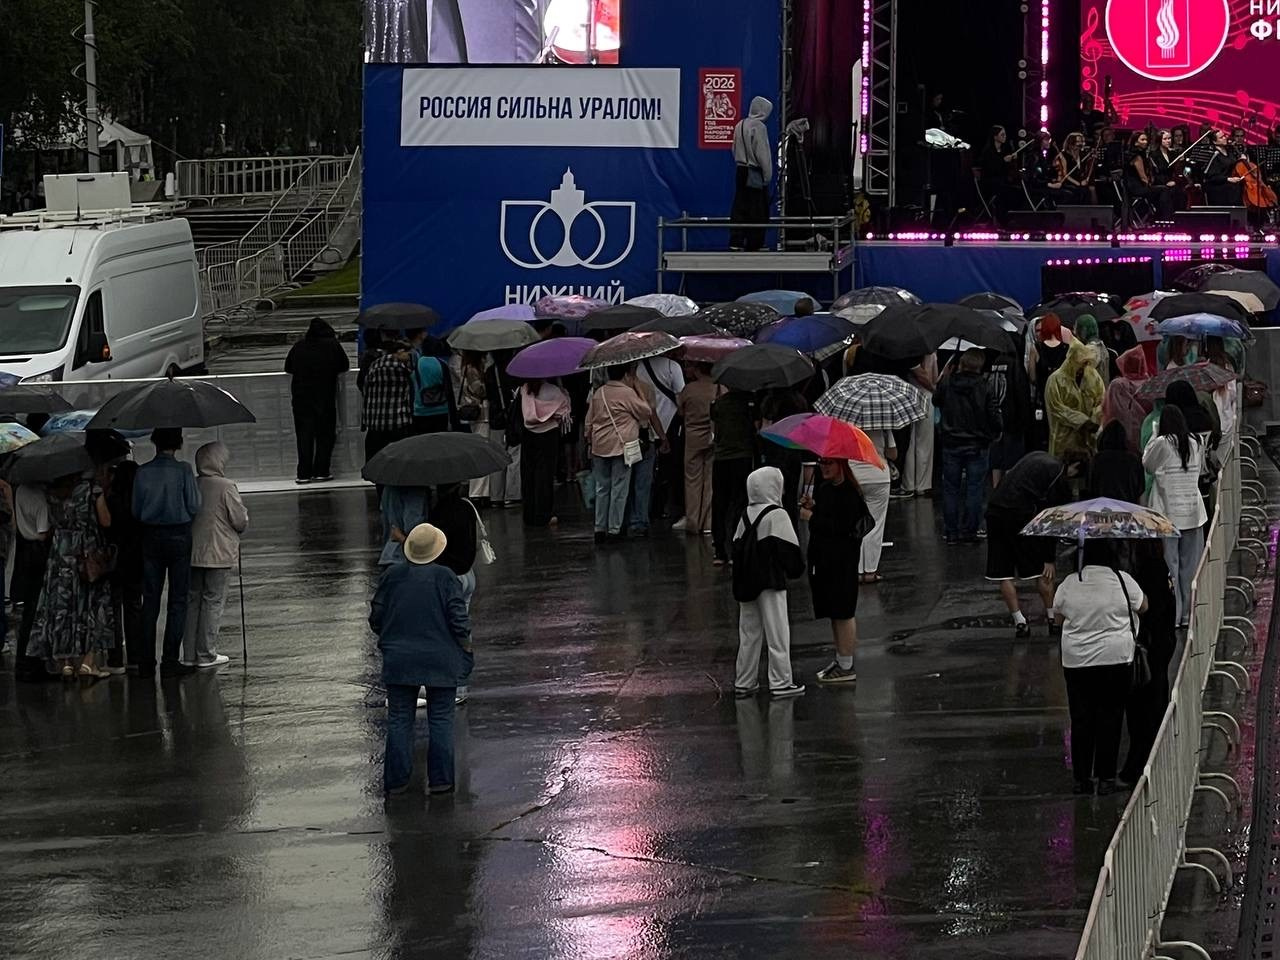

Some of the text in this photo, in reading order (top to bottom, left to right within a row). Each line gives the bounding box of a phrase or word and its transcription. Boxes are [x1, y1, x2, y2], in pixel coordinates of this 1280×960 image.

[705, 77, 735, 89] 2026
[419, 95, 662, 121] РОССИЯ СИЛЬНА УРАЛОМ!
